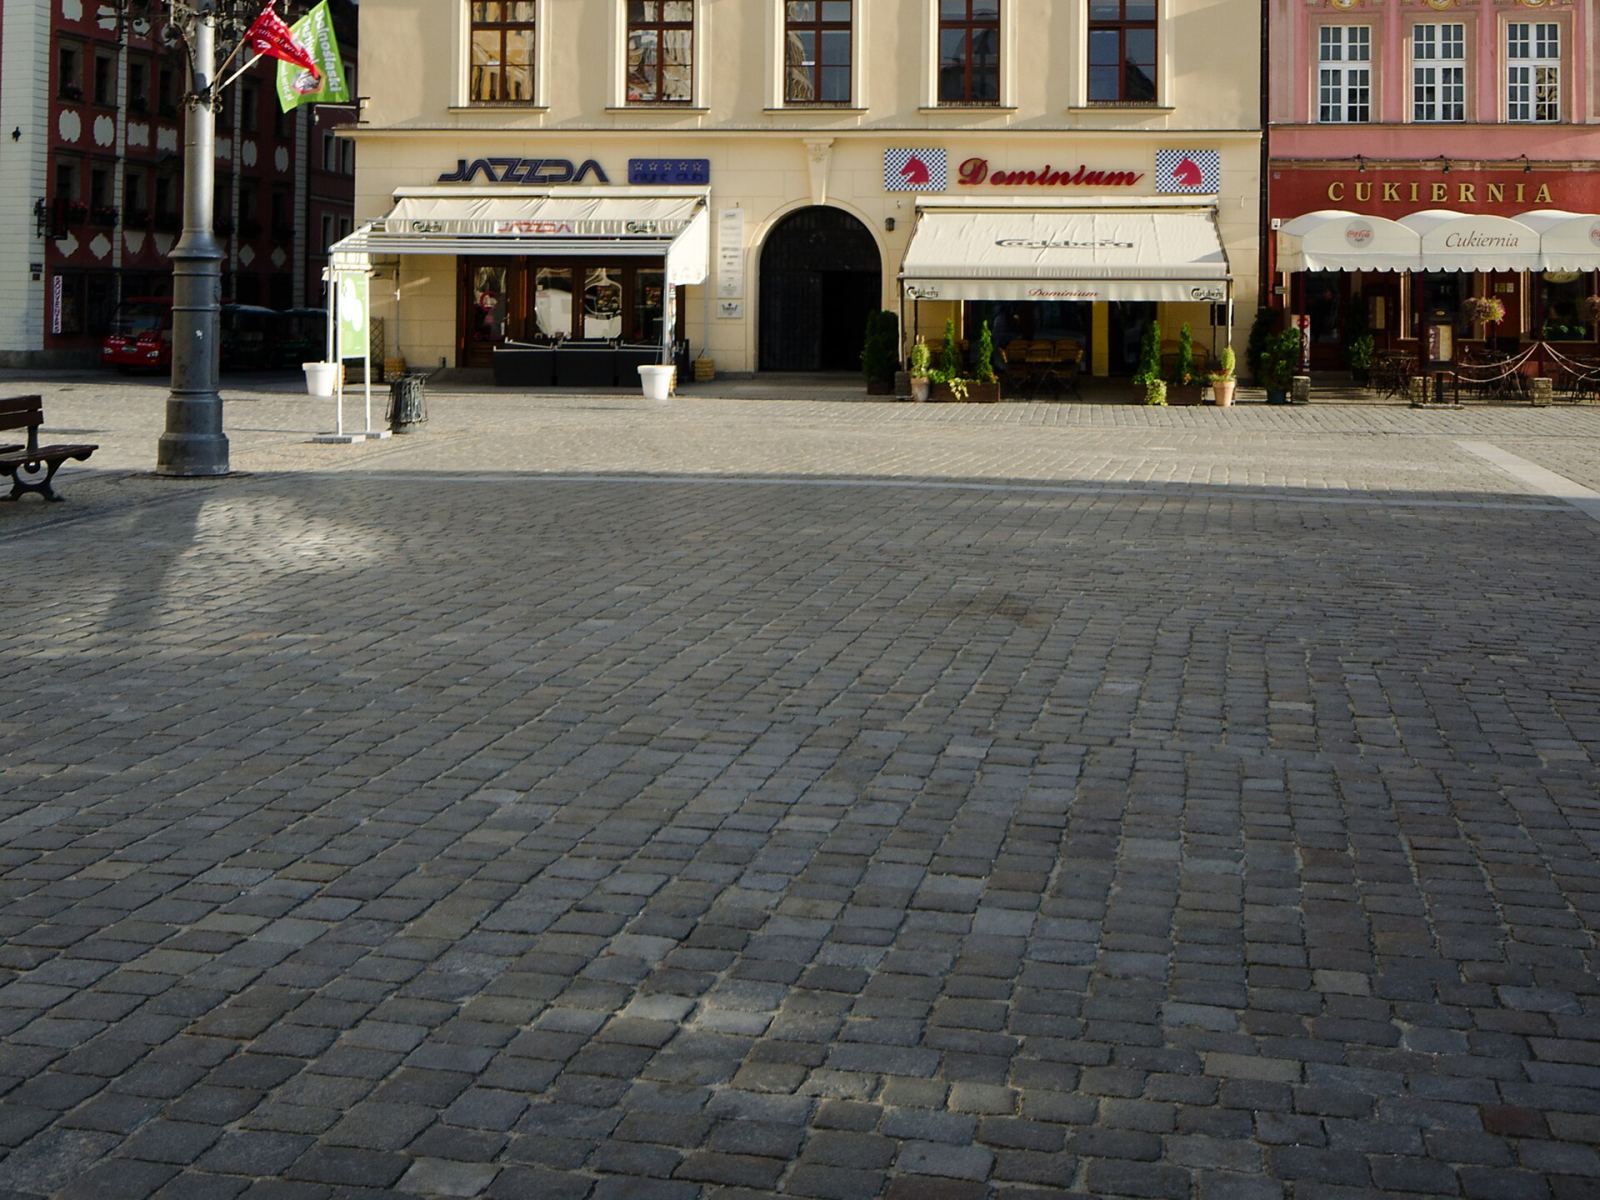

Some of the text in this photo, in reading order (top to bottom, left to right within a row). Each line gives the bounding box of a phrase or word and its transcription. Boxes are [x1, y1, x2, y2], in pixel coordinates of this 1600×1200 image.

[437, 158, 609, 184] JAZZDA
[958, 157, 1145, 186] Dominium
[1327, 182, 1553, 203] CUKIERNIA
[995, 238, 1134, 249] Carlsberg
[1445, 232, 1519, 248] Cukiernia
[1027, 289, 1099, 297] Dominium
